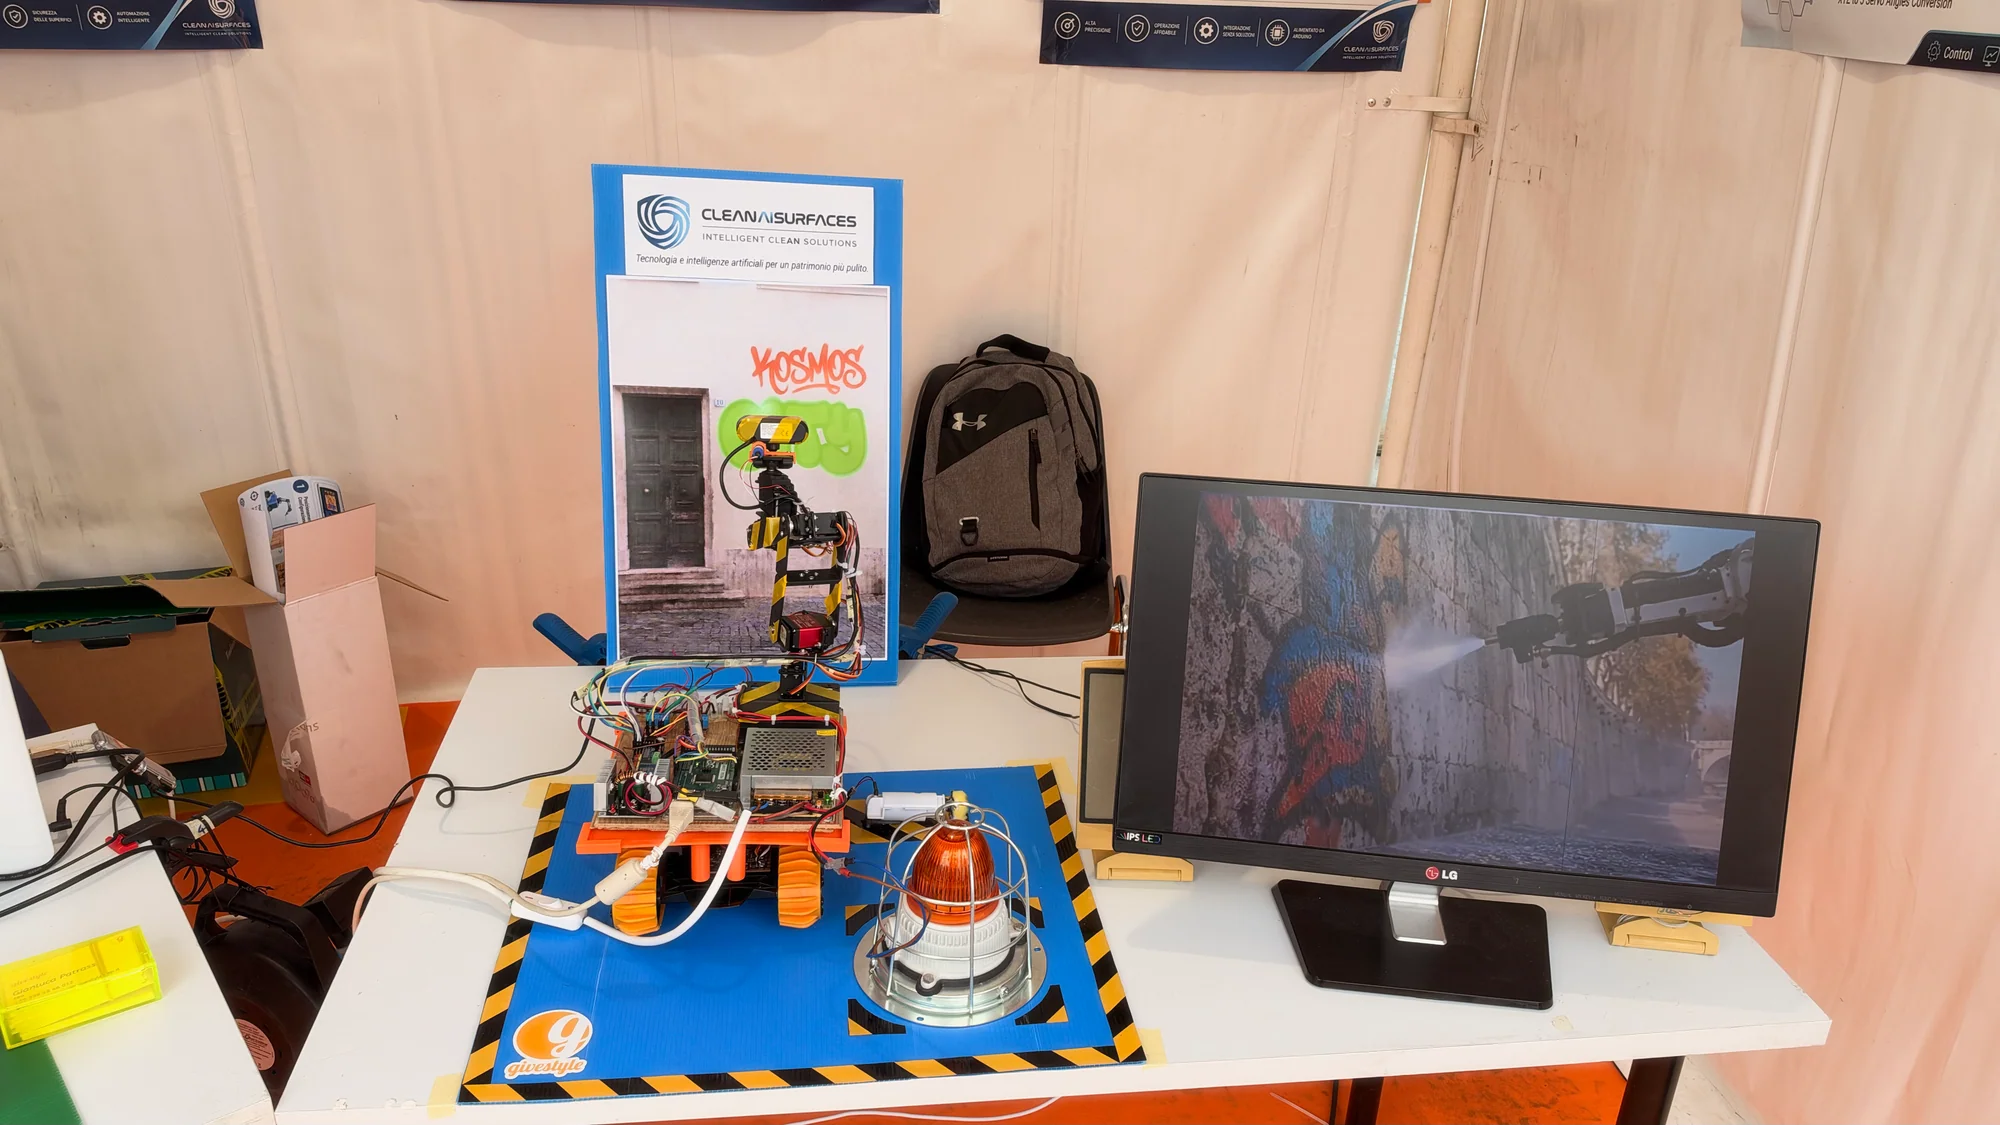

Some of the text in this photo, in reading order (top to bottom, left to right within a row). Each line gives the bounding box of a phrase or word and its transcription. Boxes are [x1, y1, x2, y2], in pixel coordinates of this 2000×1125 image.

[1884, 0, 1910, 9] Angles
[1911, 0, 1953, 9] Conversion
[1943, 46, 1974, 62] Control
[702, 233, 858, 248] INTELLIGENT CLEAN SOLUTIONS
[636, 253, 869, 273] Tecnologia e intelligenze artificiali per un patrimonio più pulito.
[750, 342, 868, 396] KOSMOS
[197, 824, 207, 834] 4
[1126, 832, 1161, 844] IPS LED
[1441, 869, 1459, 881] LG
[12, 977, 57, 997] Gianluca
[508, 1058, 584, 1076] givestyle
